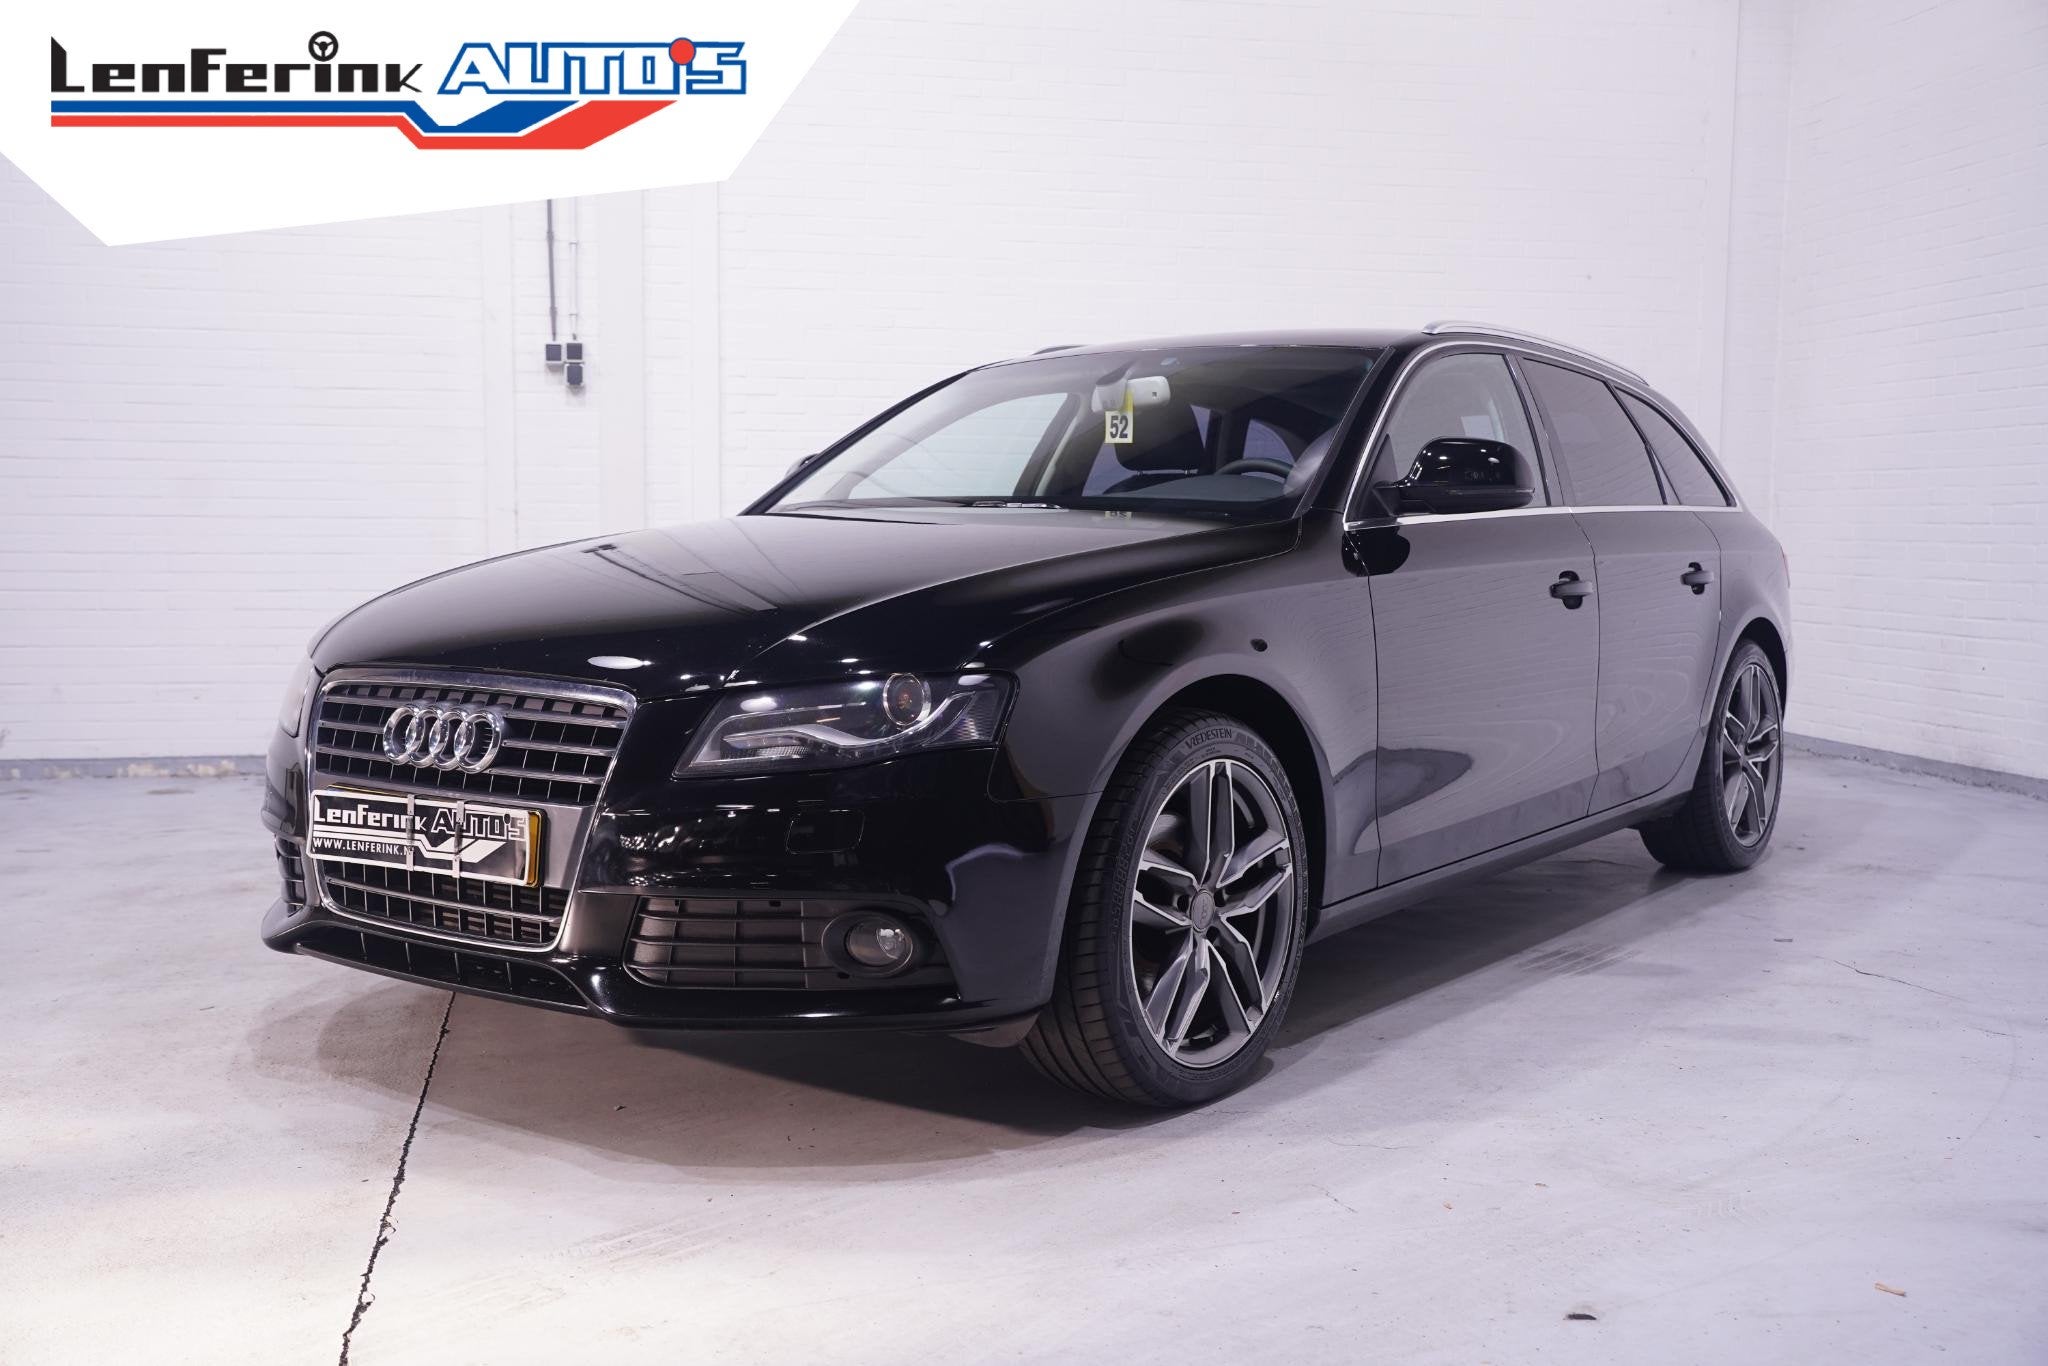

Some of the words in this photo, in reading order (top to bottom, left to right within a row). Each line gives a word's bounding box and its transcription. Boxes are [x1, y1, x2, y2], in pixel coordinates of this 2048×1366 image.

[1110, 415, 1129, 439] 52
[1185, 727, 1233, 749] VREDESTEIN
[312, 837, 414, 856] WWW.LENFERINK.N
